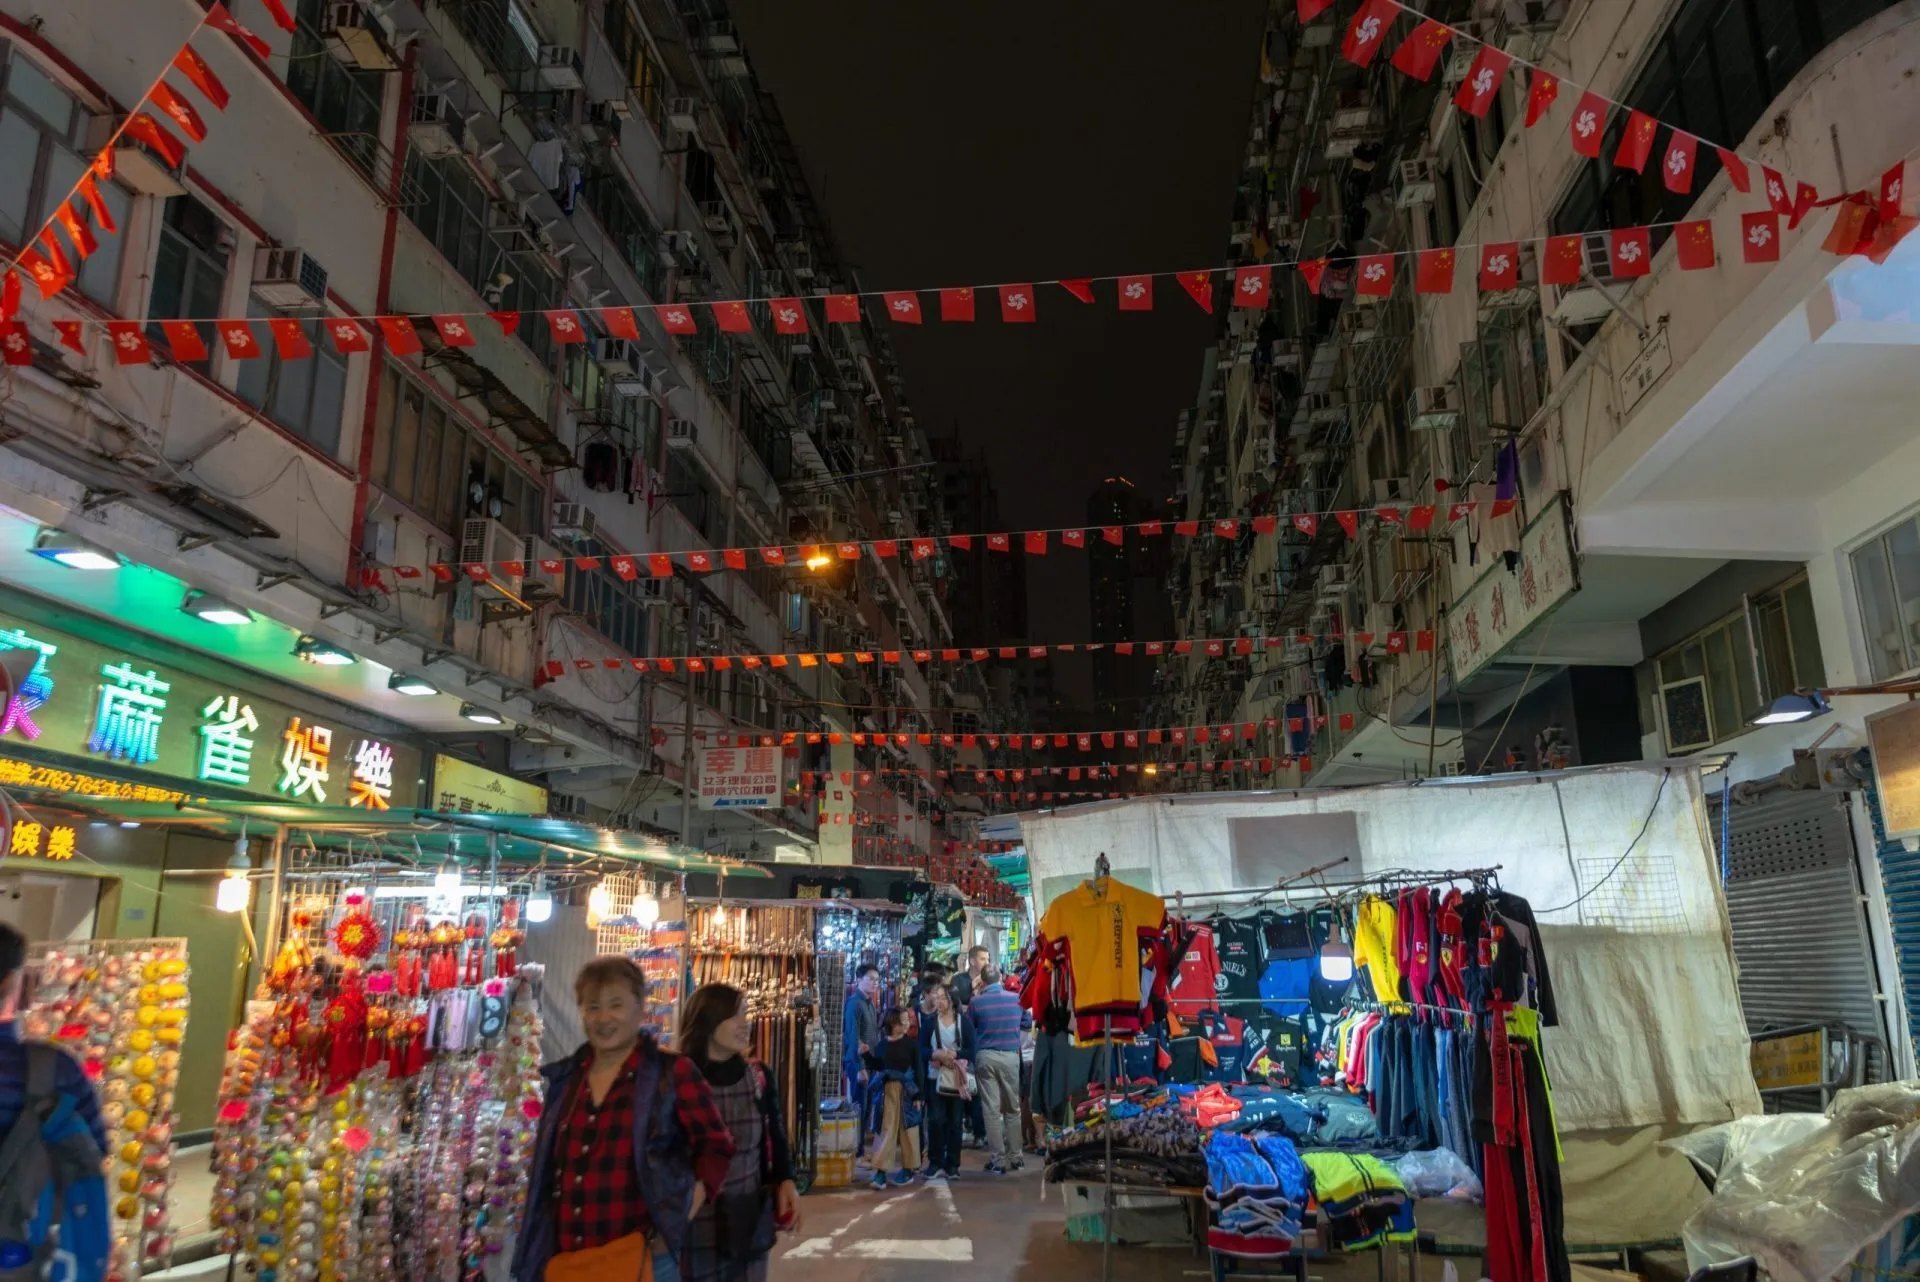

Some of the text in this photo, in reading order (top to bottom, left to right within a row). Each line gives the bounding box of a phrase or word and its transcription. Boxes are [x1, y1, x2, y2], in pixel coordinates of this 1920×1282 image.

[706, 749, 774, 774] 幸運
[10, 820, 77, 860] 娛樂
[1221, 960, 1248, 977] NIEL'S
